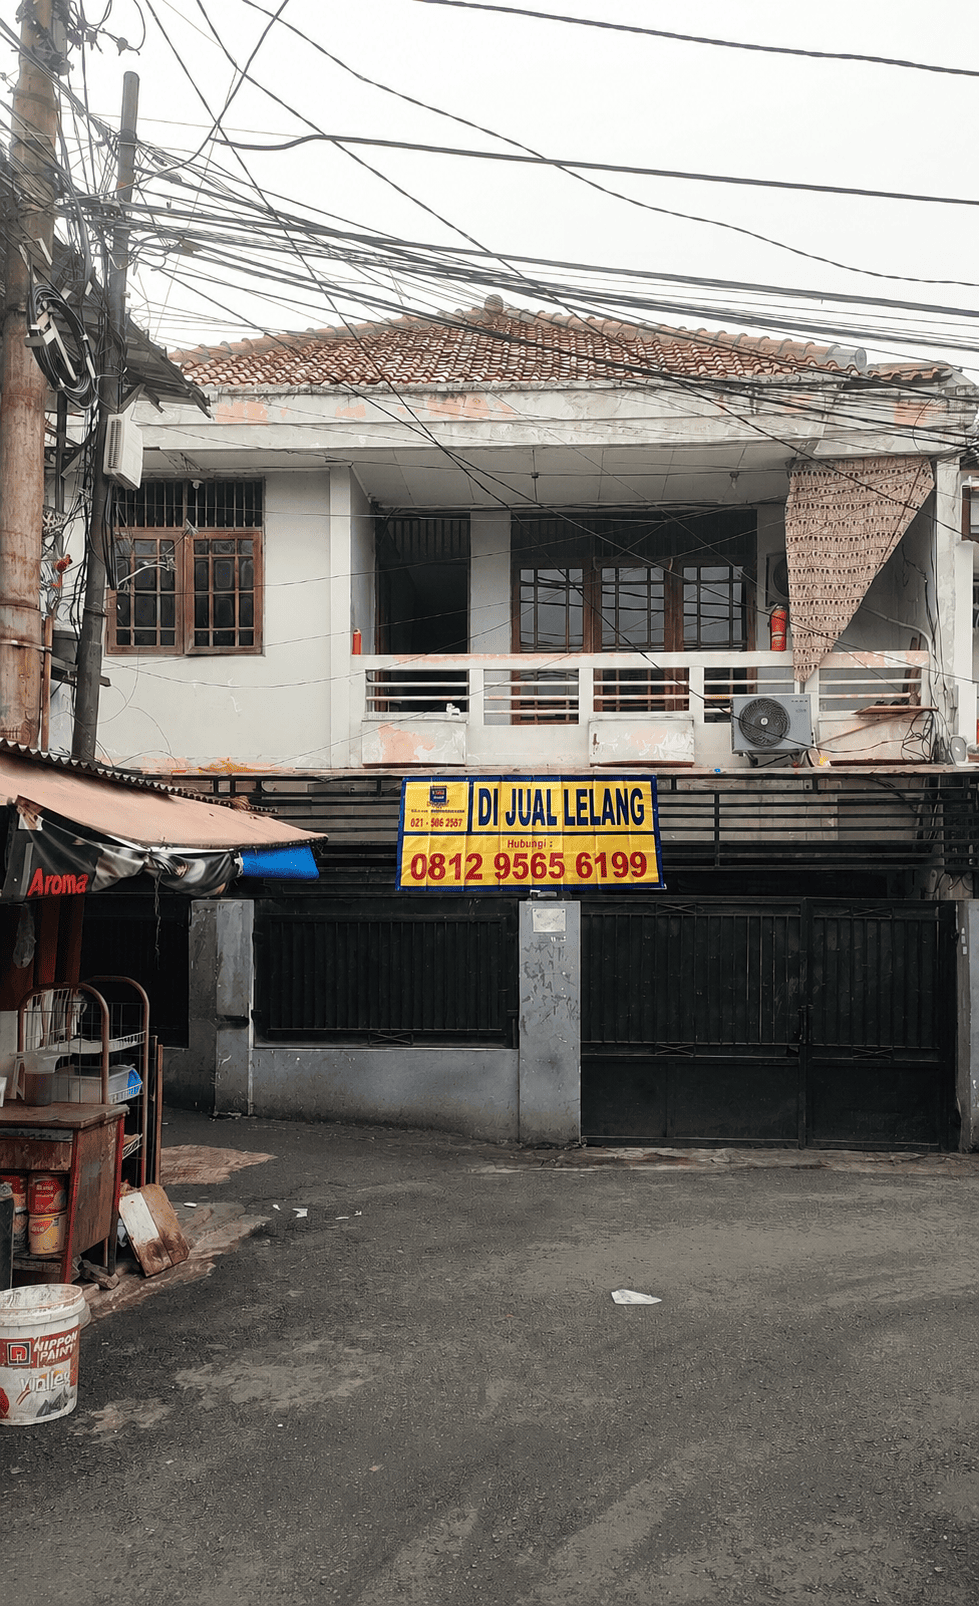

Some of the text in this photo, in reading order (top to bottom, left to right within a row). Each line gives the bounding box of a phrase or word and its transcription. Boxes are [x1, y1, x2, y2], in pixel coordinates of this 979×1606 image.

[478, 787, 645, 826] DI JUAL LELANG
[410, 818, 423, 828] 021
[507, 838, 547, 850] Hubungi
[410, 851, 648, 881] 0812 9565 6199
[27, 867, 89, 897] Aroma
[33, 1330, 78, 1352] NIPPON
[40, 1343, 74, 1363] PAINT
